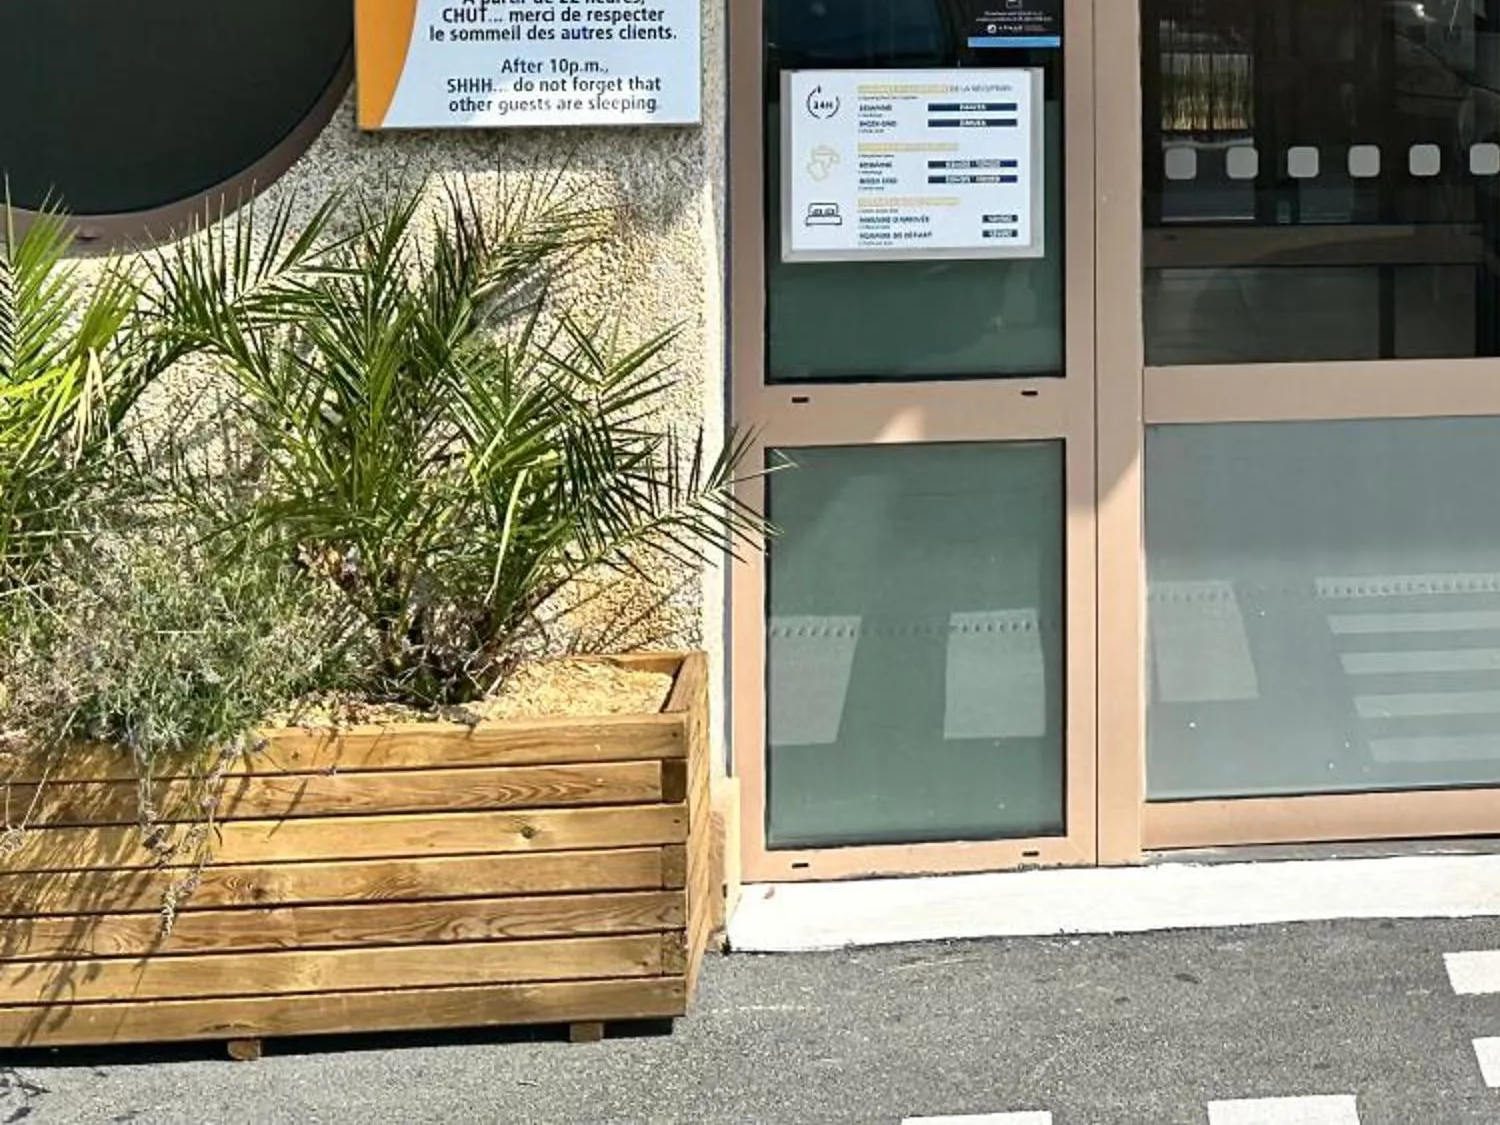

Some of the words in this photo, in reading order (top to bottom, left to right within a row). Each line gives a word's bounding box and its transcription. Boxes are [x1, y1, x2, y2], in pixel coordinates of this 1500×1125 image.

[442, 7, 503, 23] CHUT...
[509, 7, 555, 22] merci
[561, 7, 581, 22] de
[587, 8, 665, 25] respecter
[429, 26, 445, 42] le
[450, 26, 521, 42] sommeil
[526, 26, 555, 41] des
[561, 27, 613, 41] autres
[619, 25, 677, 41] clients.
[501, 58, 544, 74] After
[513, 78, 535, 92] do
[539, 78, 567, 92] not
[572, 76, 623, 95] forget
[628, 76, 662, 92] that
[449, 96, 492, 112] other
[499, 97, 551, 116] guests
[556, 98, 583, 111] are
